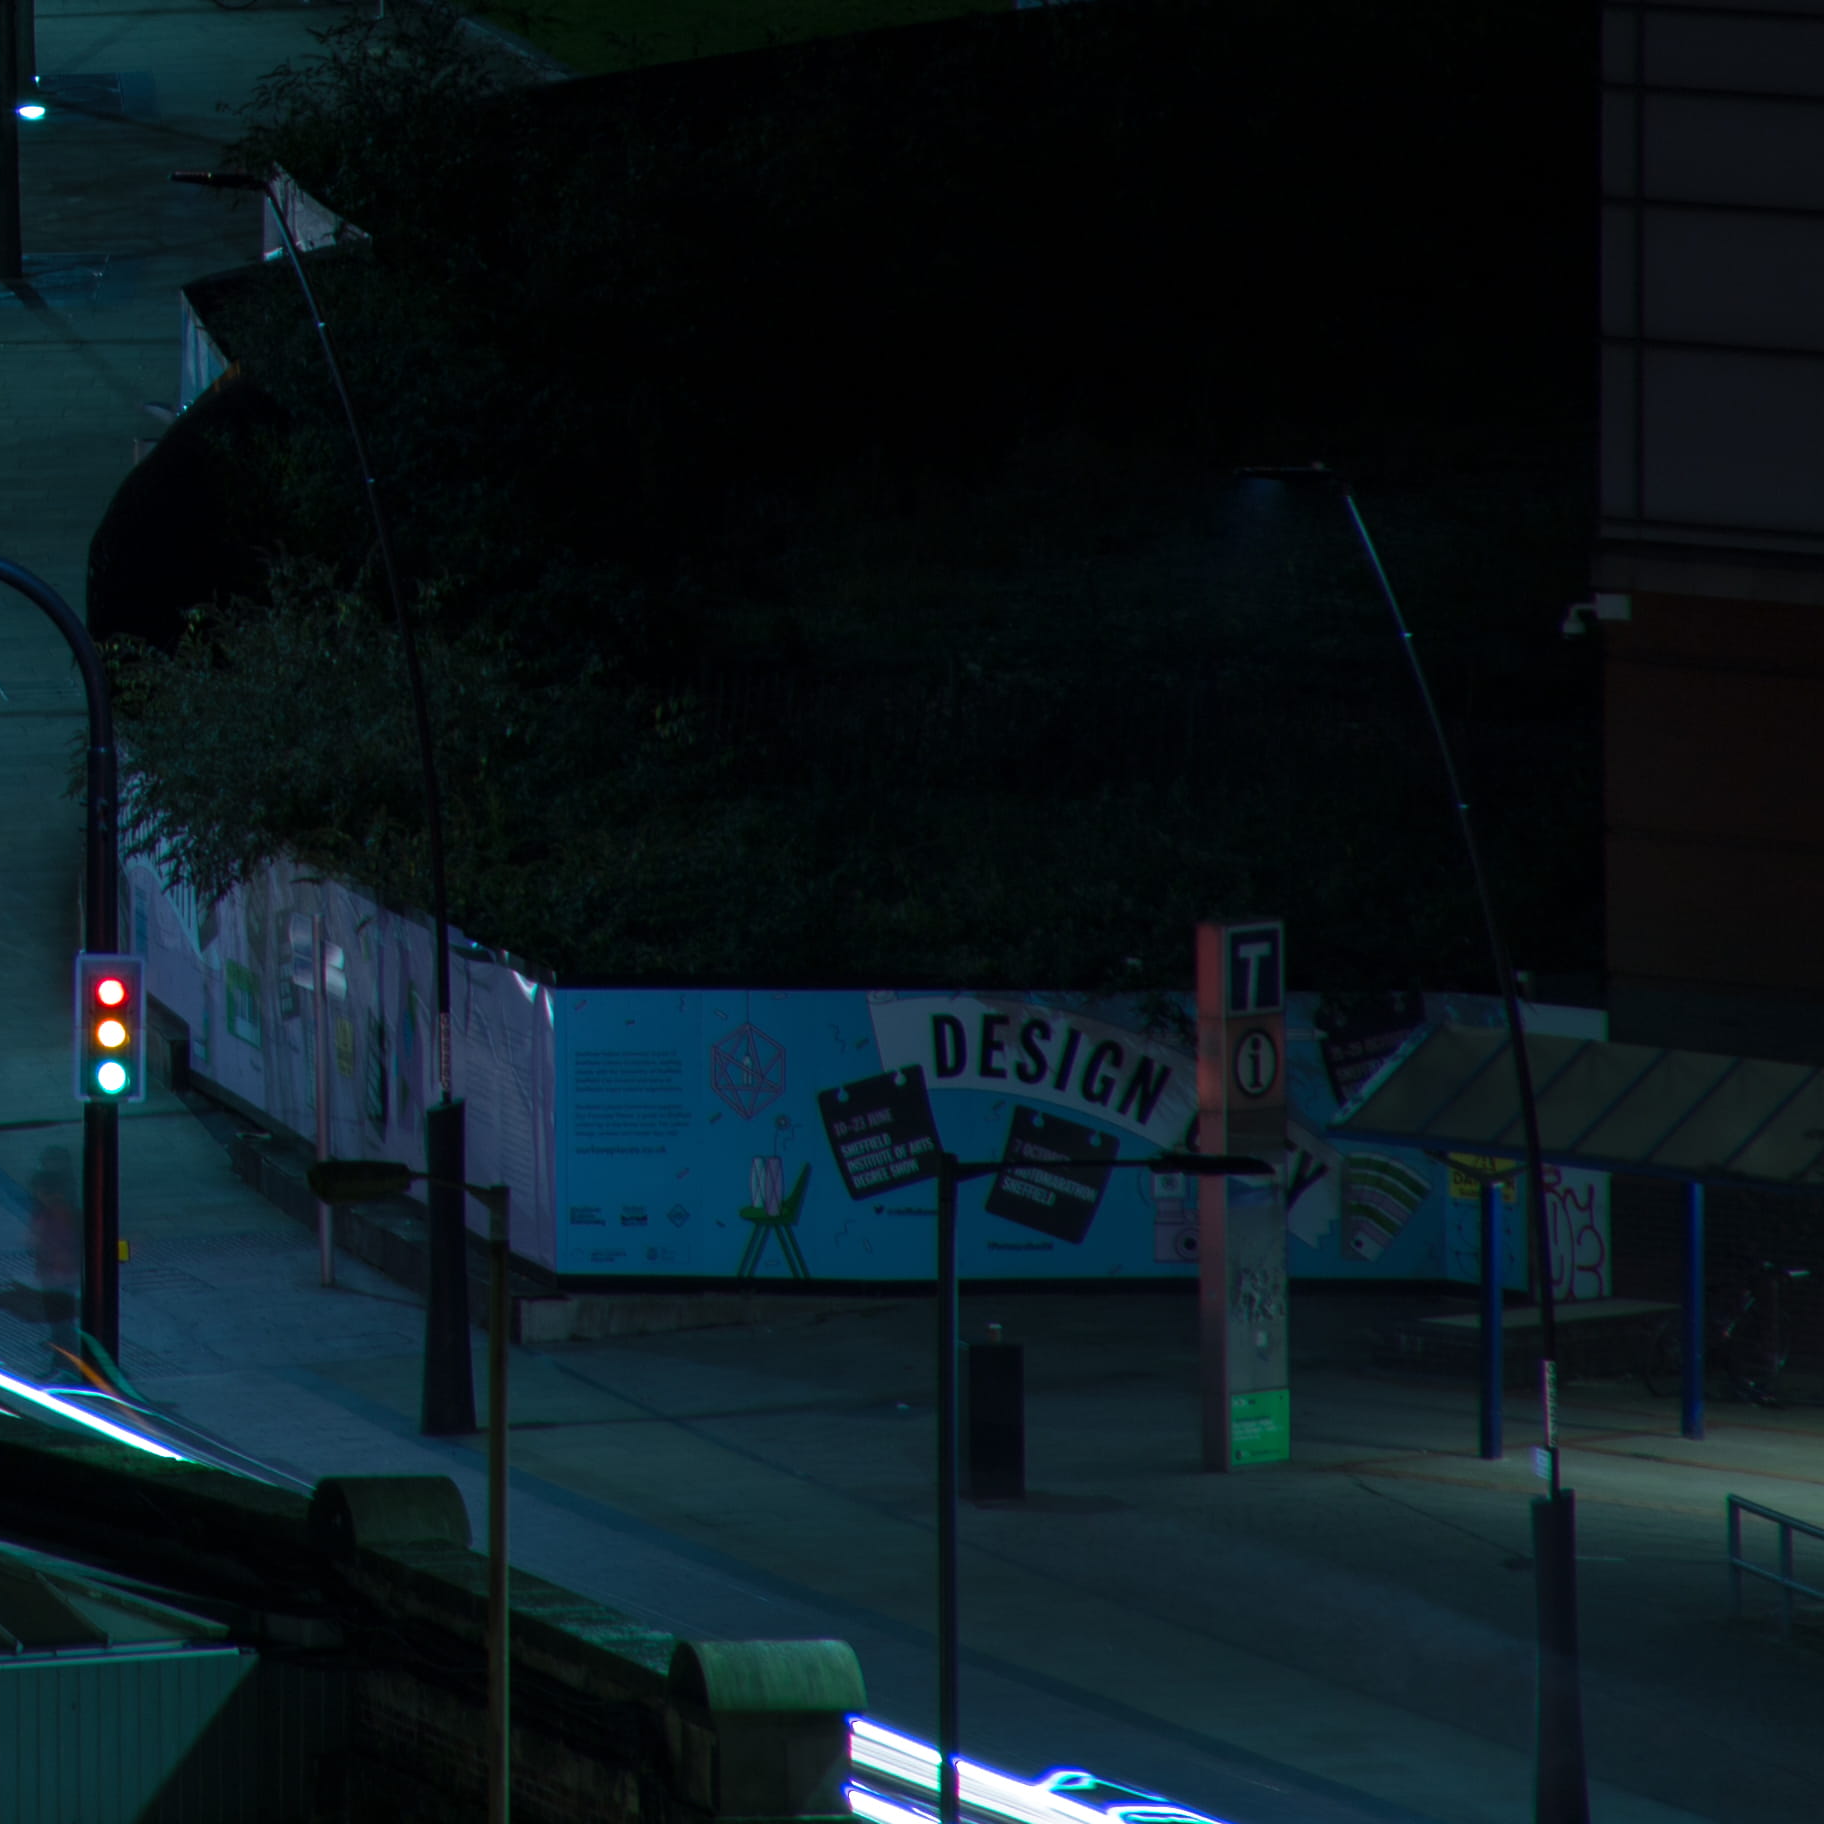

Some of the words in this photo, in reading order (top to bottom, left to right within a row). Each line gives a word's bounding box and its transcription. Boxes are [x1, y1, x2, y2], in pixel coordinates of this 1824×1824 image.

[931, 1013, 1172, 1125] DESIGN
[840, 1133, 892, 1159] SHEFFIELD
[846, 1149, 895, 1174] INSTITUTE
[909, 1137, 935, 1156] ARTS
[1001, 1176, 1057, 1207] SHEFFIELD
